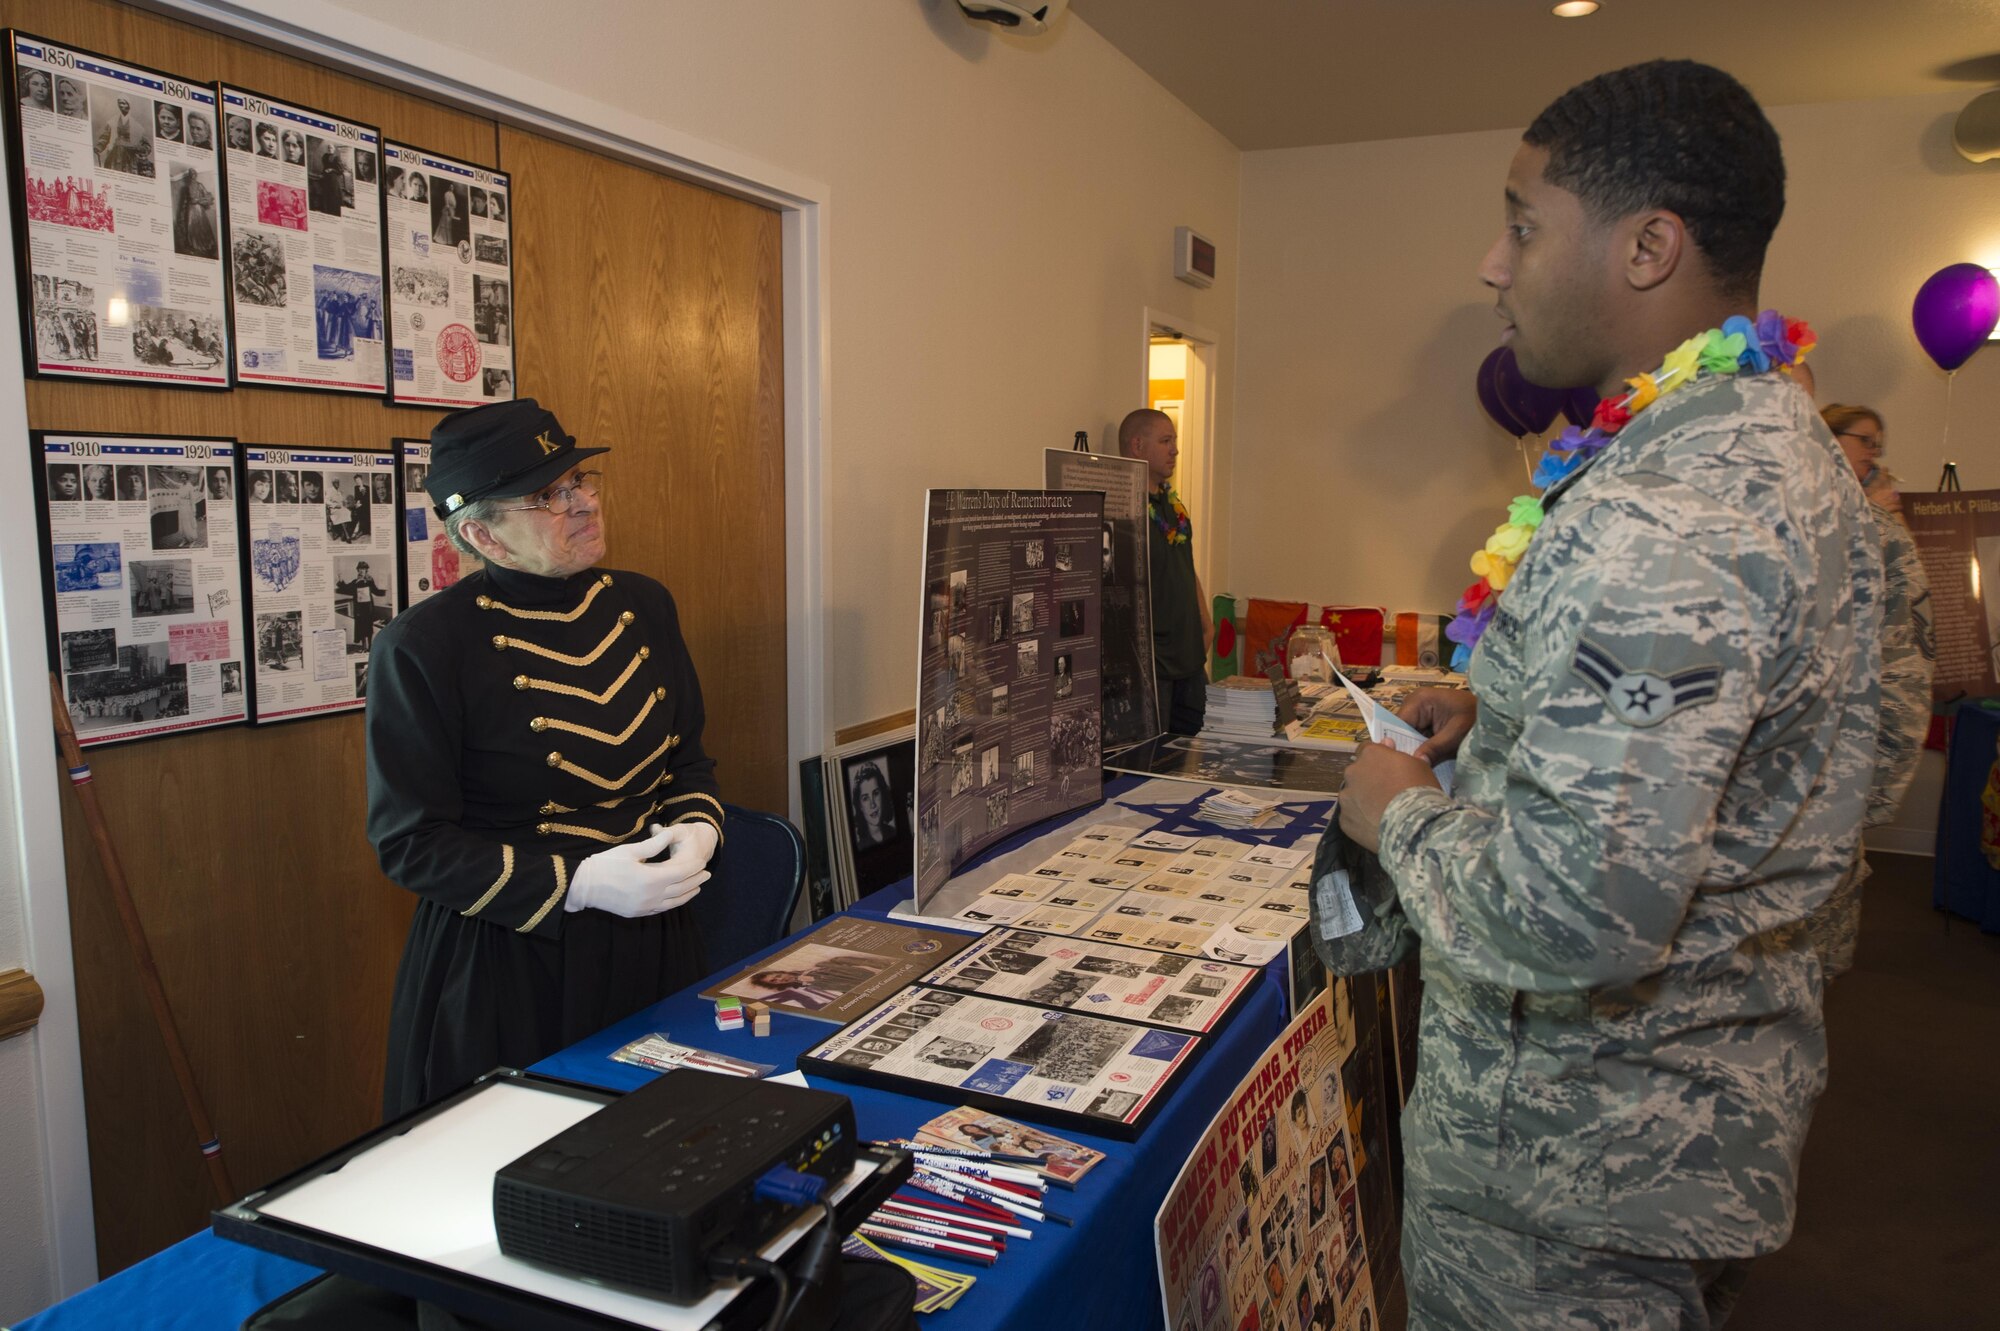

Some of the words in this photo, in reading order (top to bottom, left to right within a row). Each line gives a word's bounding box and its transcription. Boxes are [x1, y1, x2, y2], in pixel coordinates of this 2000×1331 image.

[41, 47, 75, 69] 1850
[162, 80, 192, 100] 1860
[243, 97, 269, 116] 1870
[335, 123, 360, 141] 1880
[399, 150, 421, 165] 1890
[474, 170, 493, 185] 1900
[69, 442, 100, 457] 1910
[185, 445, 212, 459] 1920
[535, 430, 561, 456] K
[265, 450, 289, 464] 1930
[353, 454, 375, 467] 1940
[957, 490, 982, 510] Warren's
[983, 491, 1000, 515] Days
[1002, 491, 1011, 508] of
[1011, 490, 1073, 509] Remembrance
[1912, 502, 1951, 515] Herbert
[1953, 501, 1965, 513] K.
[222, 663, 240, 672] VOTE
[839, 988, 870, 1012] Answering
[865, 980, 881, 996] Their
[824, 1036, 852, 1053] 1980
[1163, 1139, 1218, 1248] WOMEN
[1220, 1055, 1283, 1151] PUTTING
[1282, 1004, 1328, 1062] THEIR
[1308, 1120, 1339, 1158] Actors
[960, 1149, 991, 1158] WOMEN
[959, 1165, 989, 1178] WOMEN
[1169, 1178, 1217, 1285] STAMP
[1219, 1145, 1240, 1190] ON
[1241, 1060, 1301, 1158] HISTORY
[935, 1187, 965, 1203] WOMEN
[1259, 1149, 1300, 1224] Activists
[1233, 1251, 1264, 1314] Artists
